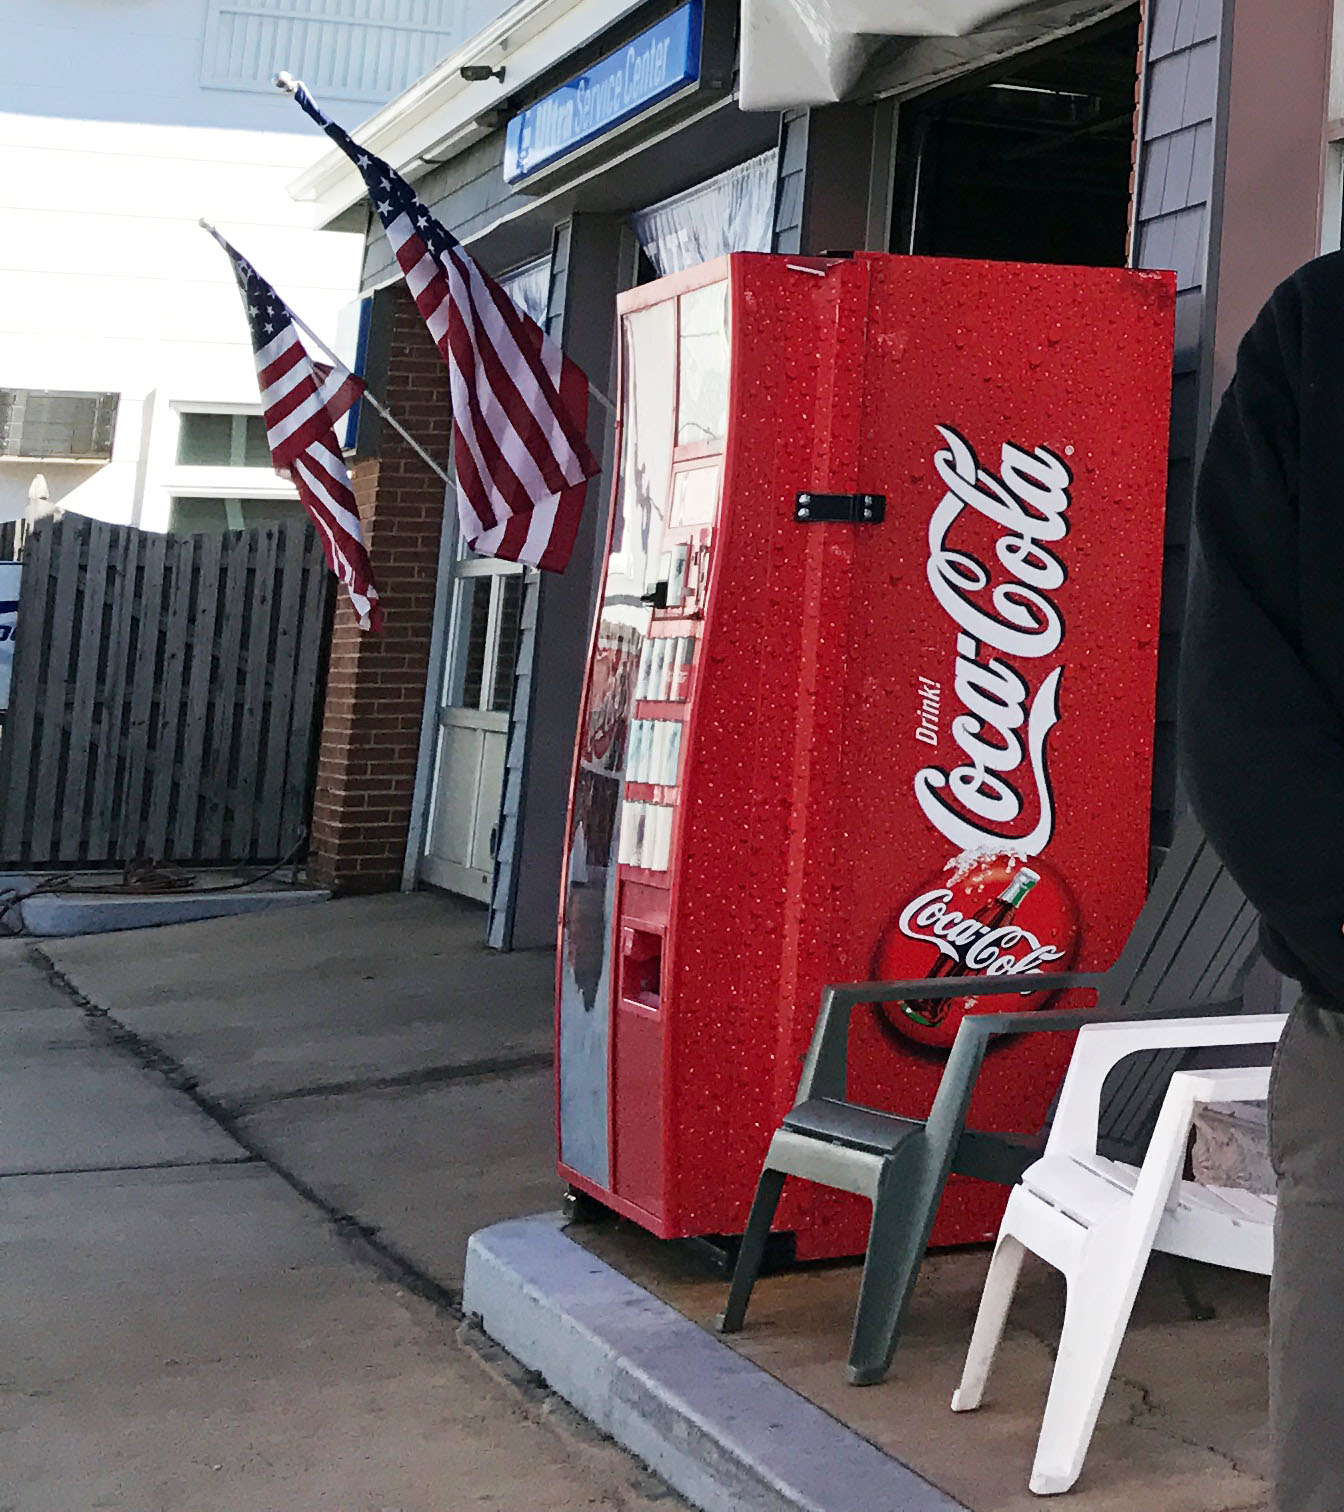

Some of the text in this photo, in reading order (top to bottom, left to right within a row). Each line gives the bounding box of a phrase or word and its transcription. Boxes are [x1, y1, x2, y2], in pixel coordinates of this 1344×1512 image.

[535, 37, 670, 140] Ultra Service Center
[914, 424, 1073, 856] Coca-Cola
[915, 676, 941, 747] Drink!
[899, 888, 1066, 978] Coca-Col
